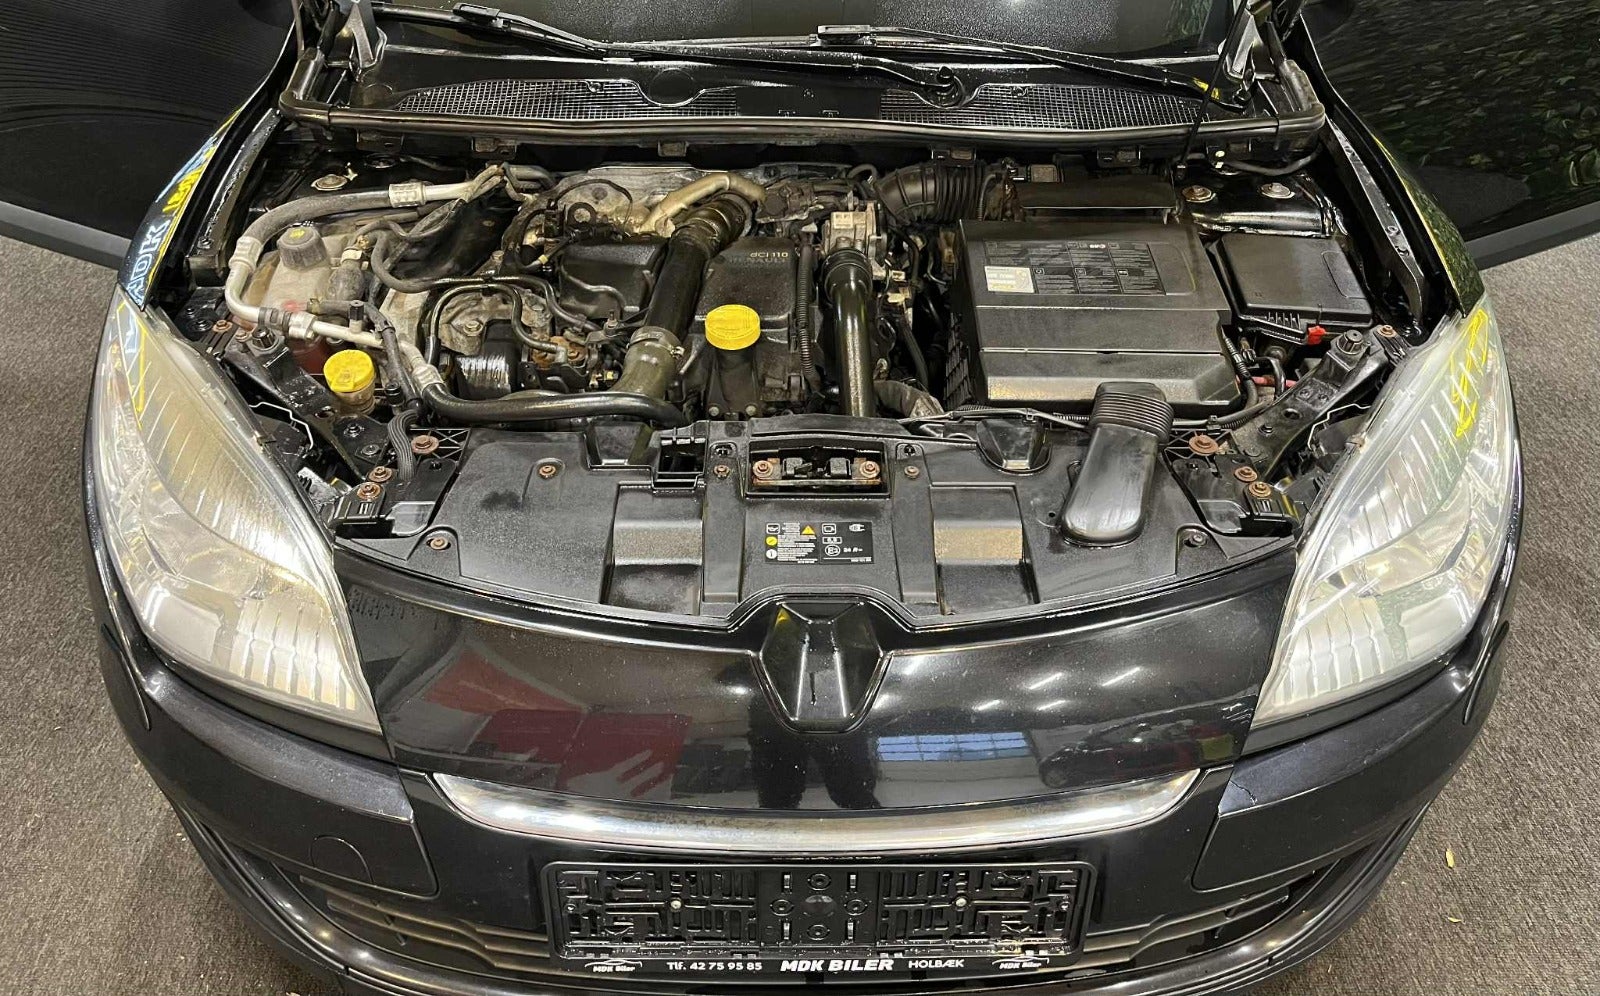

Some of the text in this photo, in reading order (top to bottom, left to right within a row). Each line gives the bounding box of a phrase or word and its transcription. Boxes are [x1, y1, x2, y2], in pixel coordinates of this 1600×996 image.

[667, 959, 965, 972] Tlf. 42 75 95 85 MDK BILER HOLBÆK
